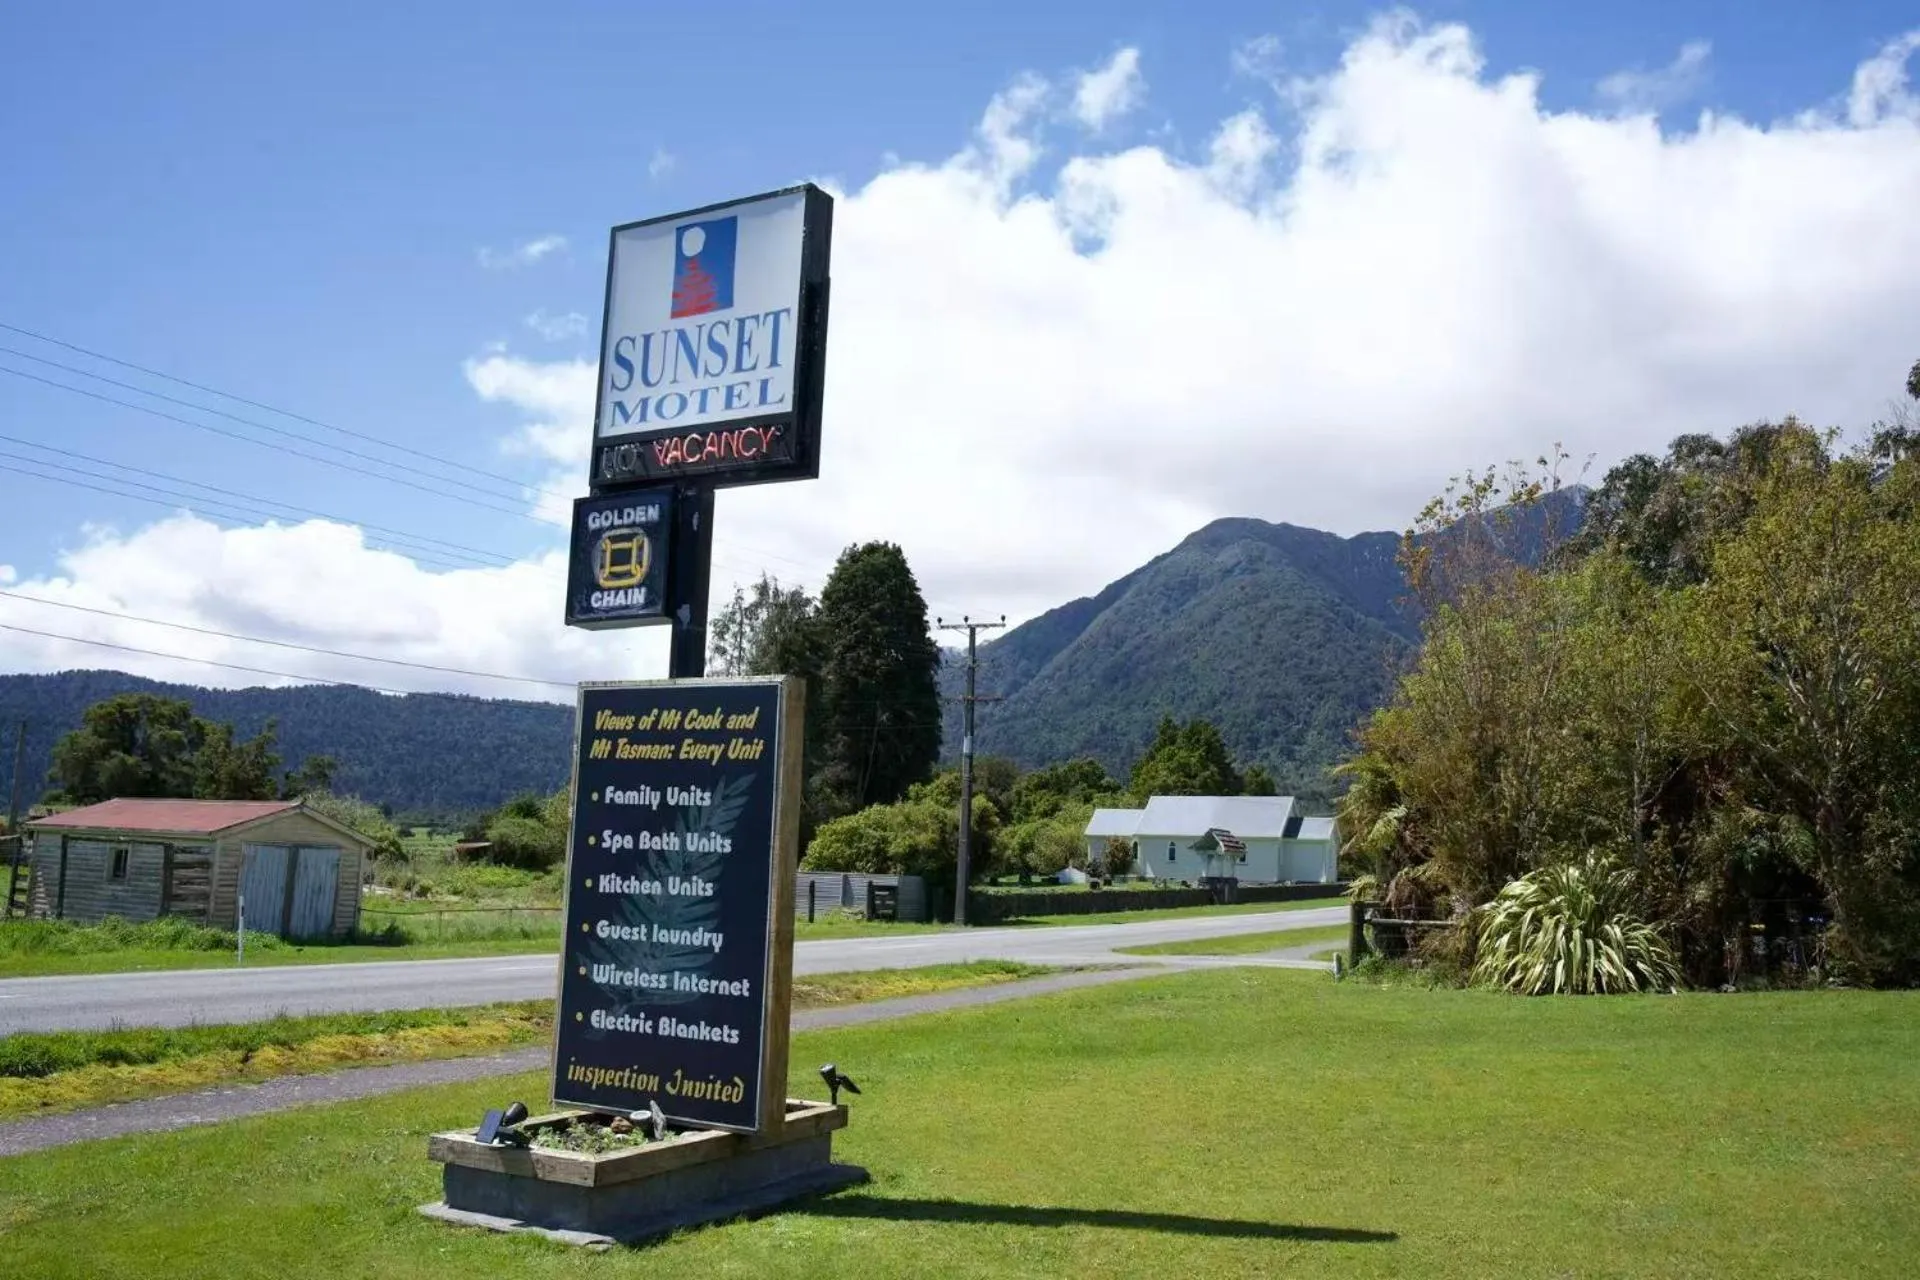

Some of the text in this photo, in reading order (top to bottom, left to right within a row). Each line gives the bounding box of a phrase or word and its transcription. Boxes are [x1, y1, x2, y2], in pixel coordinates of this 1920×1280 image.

[610, 307, 792, 393] SUNSET
[611, 377, 786, 428] MOTEL
[653, 426, 777, 466] VACANCY
[588, 504, 659, 529] GOLDEN
[590, 587, 647, 608] CHAIN
[595, 706, 760, 731] Views of Mt Cook and
[589, 739, 611, 759] Mt
[679, 738, 724, 766] Every
[727, 738, 765, 760] Unit
[604, 784, 712, 811] Family Units
[601, 829, 732, 853] Spa Bath Units
[599, 872, 714, 897] Kitchen Units
[596, 920, 724, 953] Guest laundry
[592, 963, 750, 998] Wireless Internet
[590, 1009, 740, 1044] Electric Blankets
[567, 1056, 745, 1104] inspection Invited
